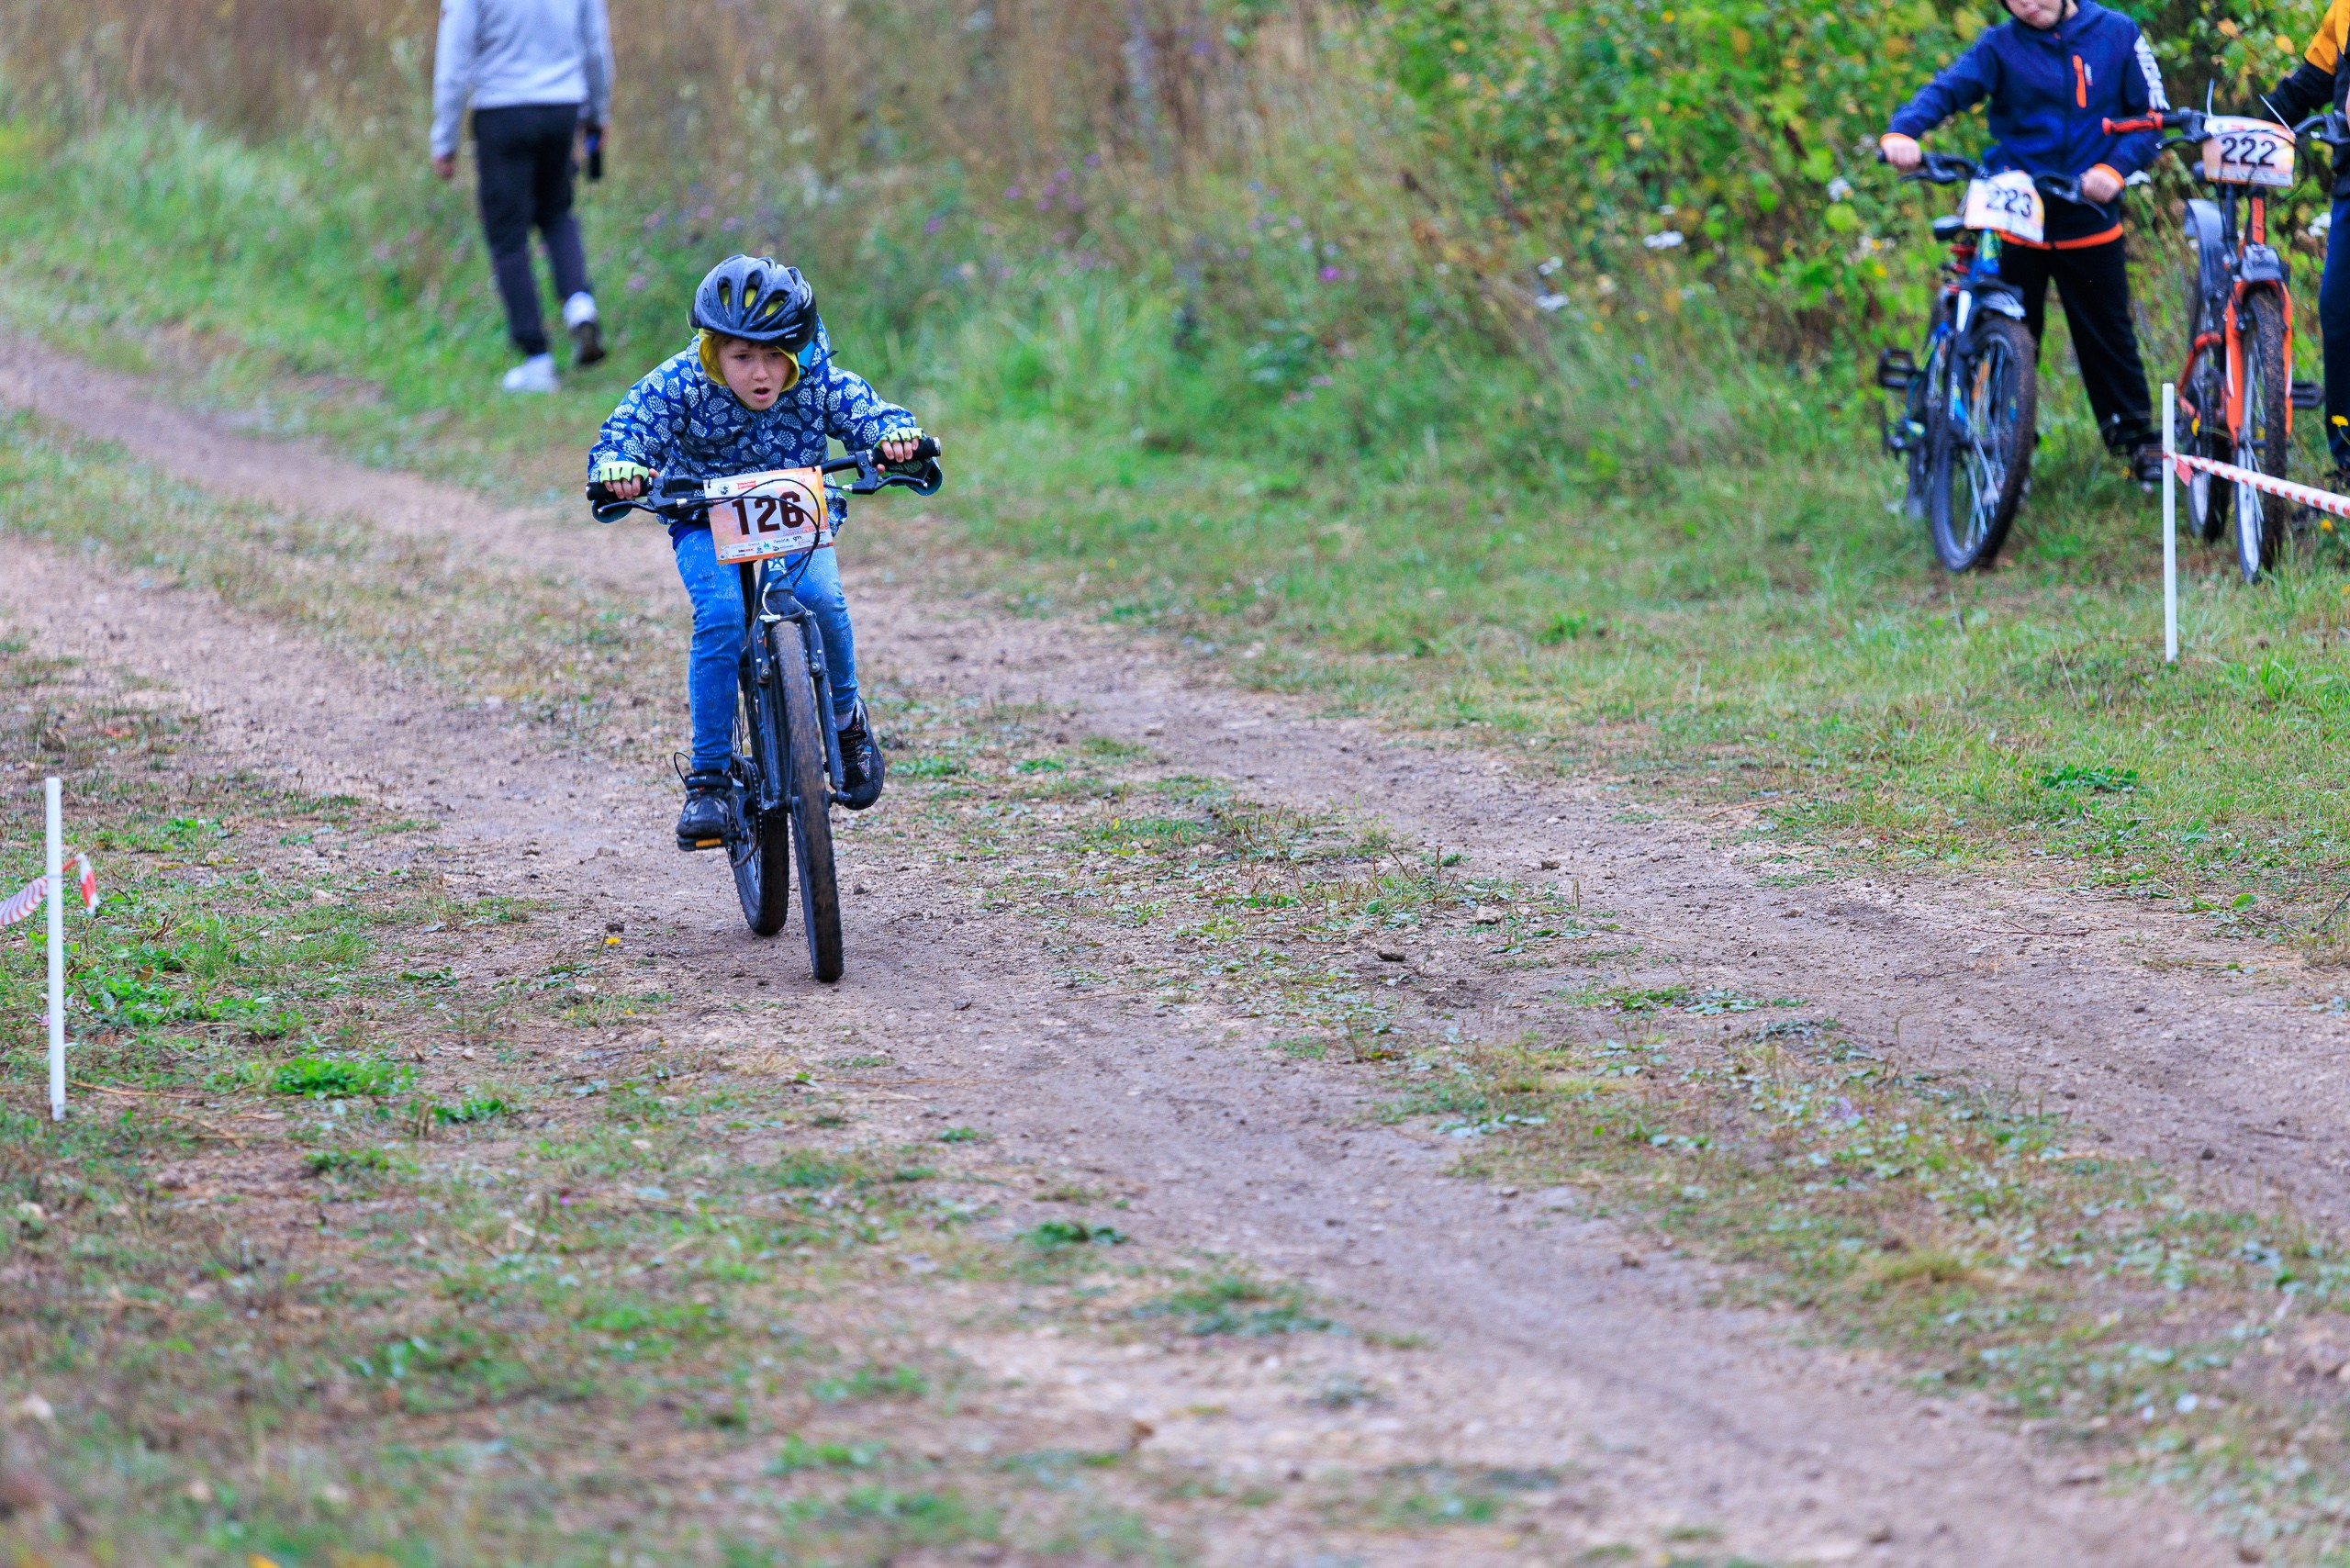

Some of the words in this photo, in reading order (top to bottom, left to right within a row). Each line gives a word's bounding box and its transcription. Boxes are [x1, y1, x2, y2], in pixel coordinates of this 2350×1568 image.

[2221, 136, 2277, 166] 222
[1986, 189, 2032, 218] 223
[732, 491, 805, 536] 126
